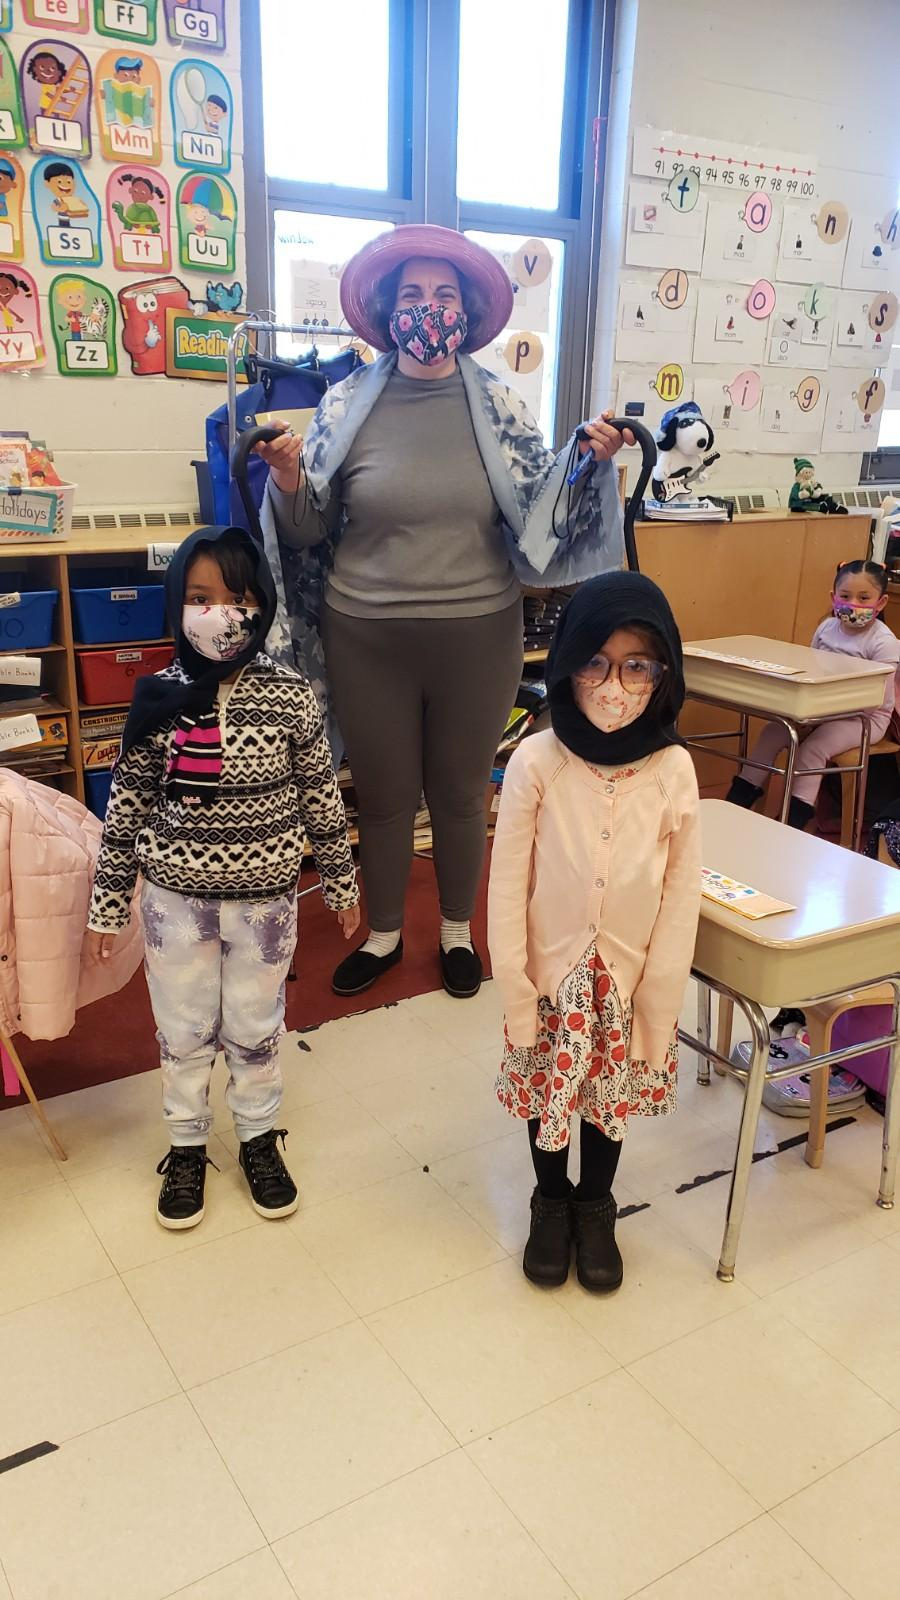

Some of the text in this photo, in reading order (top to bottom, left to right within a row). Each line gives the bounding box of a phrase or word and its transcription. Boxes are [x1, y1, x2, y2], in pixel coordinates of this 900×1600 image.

[46, 0, 68, 14] Ee
[117, 10, 135, 25] Ff
[183, 13, 209, 38] Gg
[114, 129, 149, 150] Mm
[190, 136, 215, 157] Nn
[654, 160, 665, 174] 91
[705, 169, 717, 182] 94
[721, 171, 734, 184] 95
[738, 173, 750, 187] 96
[754, 176, 766, 190] 97
[770, 178, 782, 192] 98
[786, 181, 798, 194] 99
[800, 181, 815, 196] 100
[750, 201, 767, 226] a
[824, 213, 838, 236] n
[59, 232, 81, 251] Ss
[132, 239, 151, 257] Tt
[195, 238, 219, 257] Uu
[665, 271, 680, 301] d
[809, 289, 819, 315] k
[0, 339, 23, 359] Yy
[178, 327, 245, 357] Readin!
[75, 346, 98, 362] Zz
[514, 339, 530, 373] p
[660, 371, 680, 396] m
[741, 379, 750, 406] i
[863, 380, 878, 410] f
[802, 386, 814, 409] g
[152, 544, 176, 566] boo
